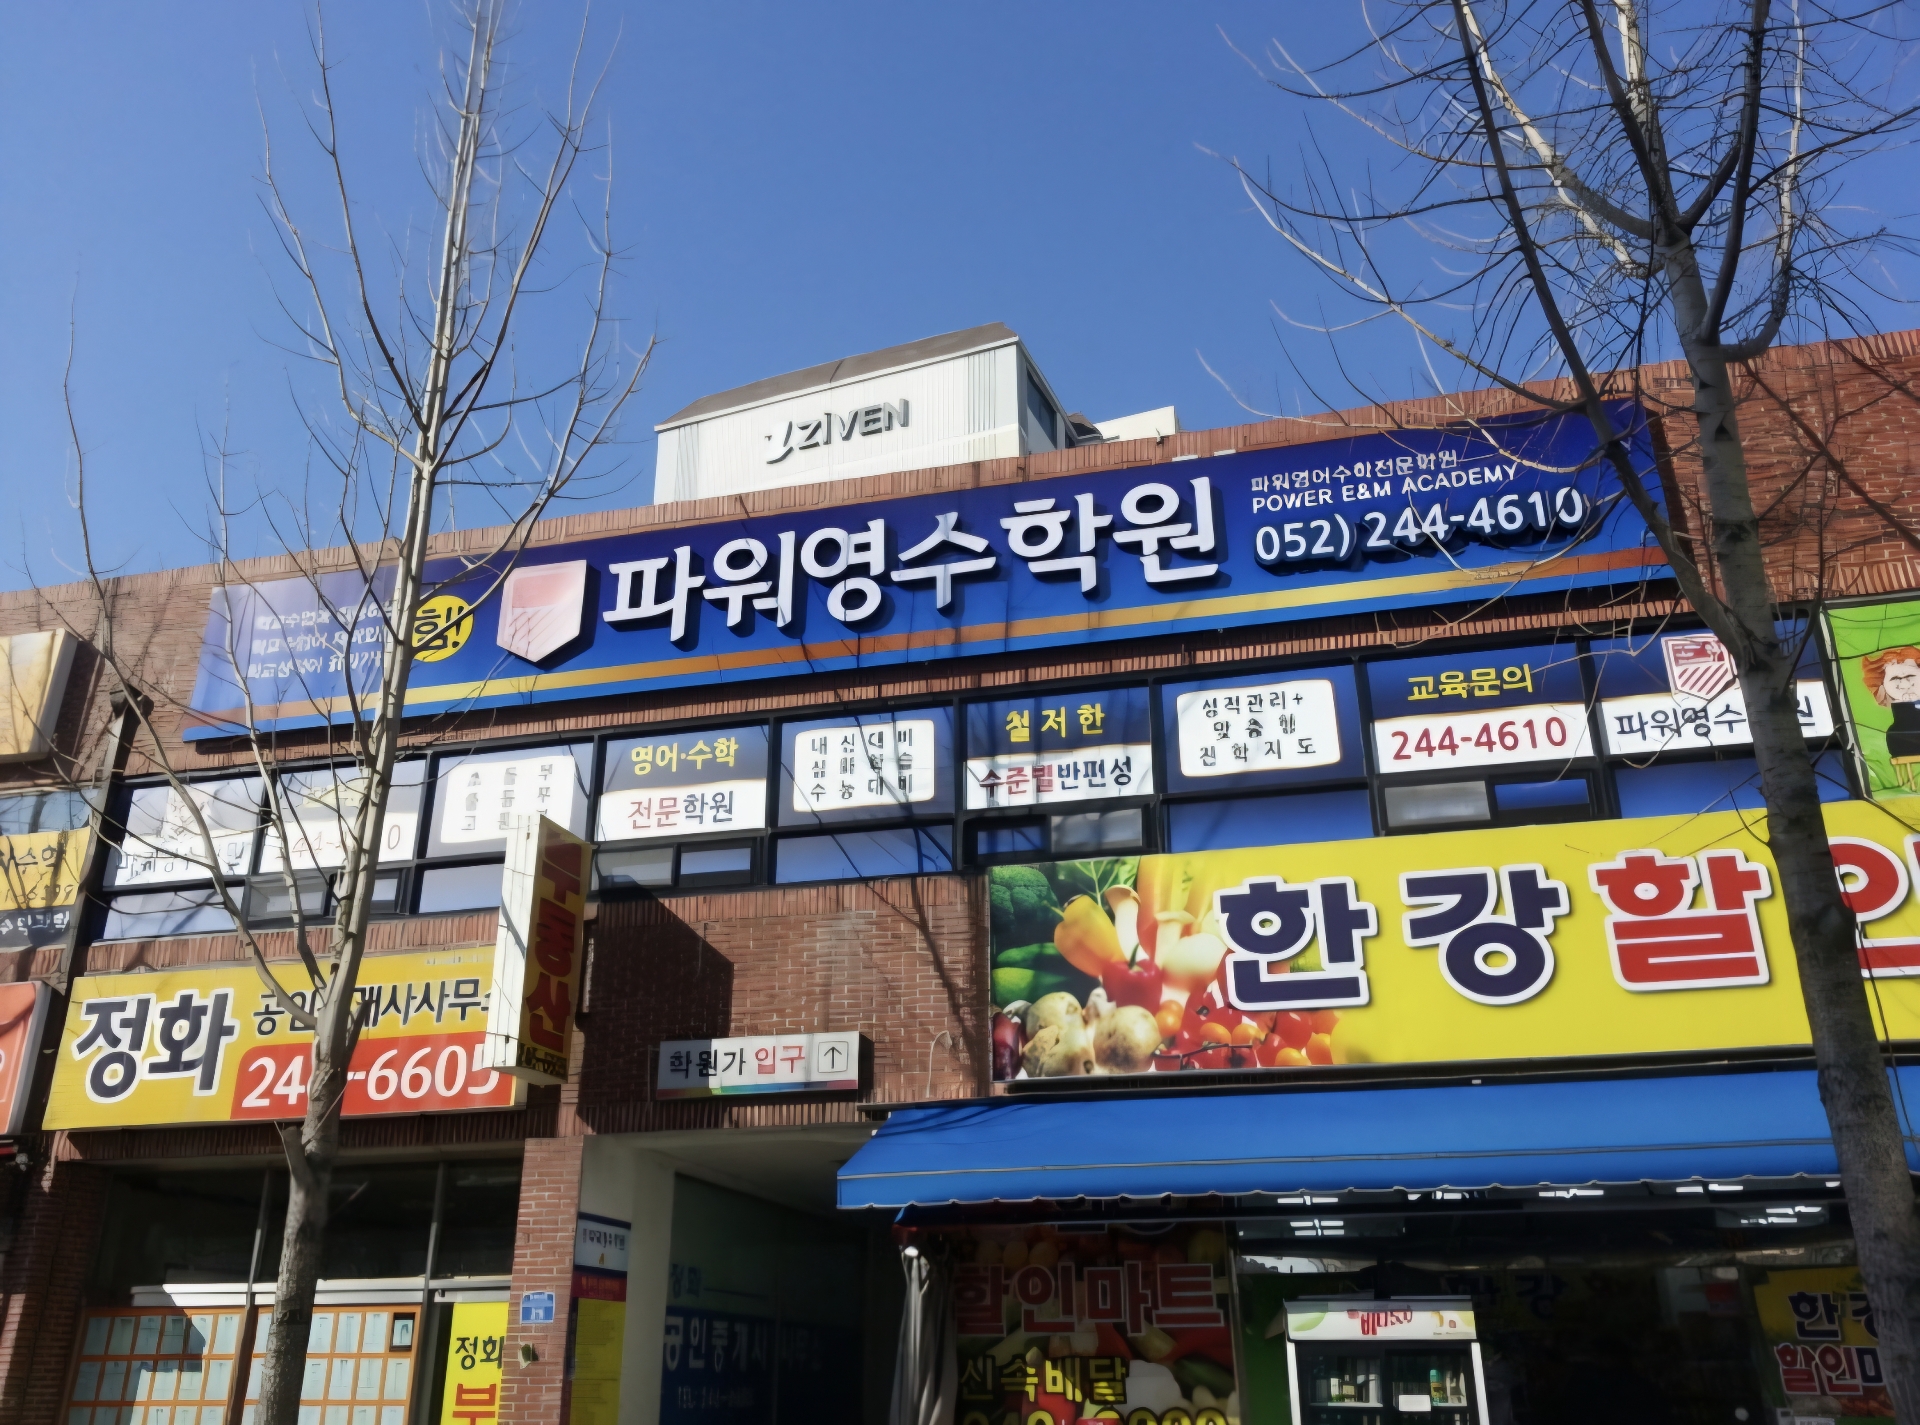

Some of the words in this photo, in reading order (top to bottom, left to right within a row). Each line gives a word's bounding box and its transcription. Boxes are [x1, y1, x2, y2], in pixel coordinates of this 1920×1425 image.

[1252, 489, 1333, 513] POWER
[1342, 480, 1392, 502] E&M
[1401, 461, 1518, 495] ACADEMY
[1364, 486, 1583, 548] 244-4610
[603, 476, 1219, 642] 파워영수학원
[1407, 663, 1533, 701] 교육문의
[1391, 716, 1567, 760] 244-4610
[1614, 695, 1815, 741] 파워영수원
[627, 791, 734, 830] 전문학원
[253, 977, 491, 1037] 공인개사사무
[74, 990, 238, 1102] 정화
[669, 1047, 746, 1079] 학원가
[755, 1045, 806, 1075] 입구
[241, 1044, 500, 1109] 24-6605
[953, 1260, 1225, 1338] 할인마트
[455, 1335, 505, 1370] 정화
